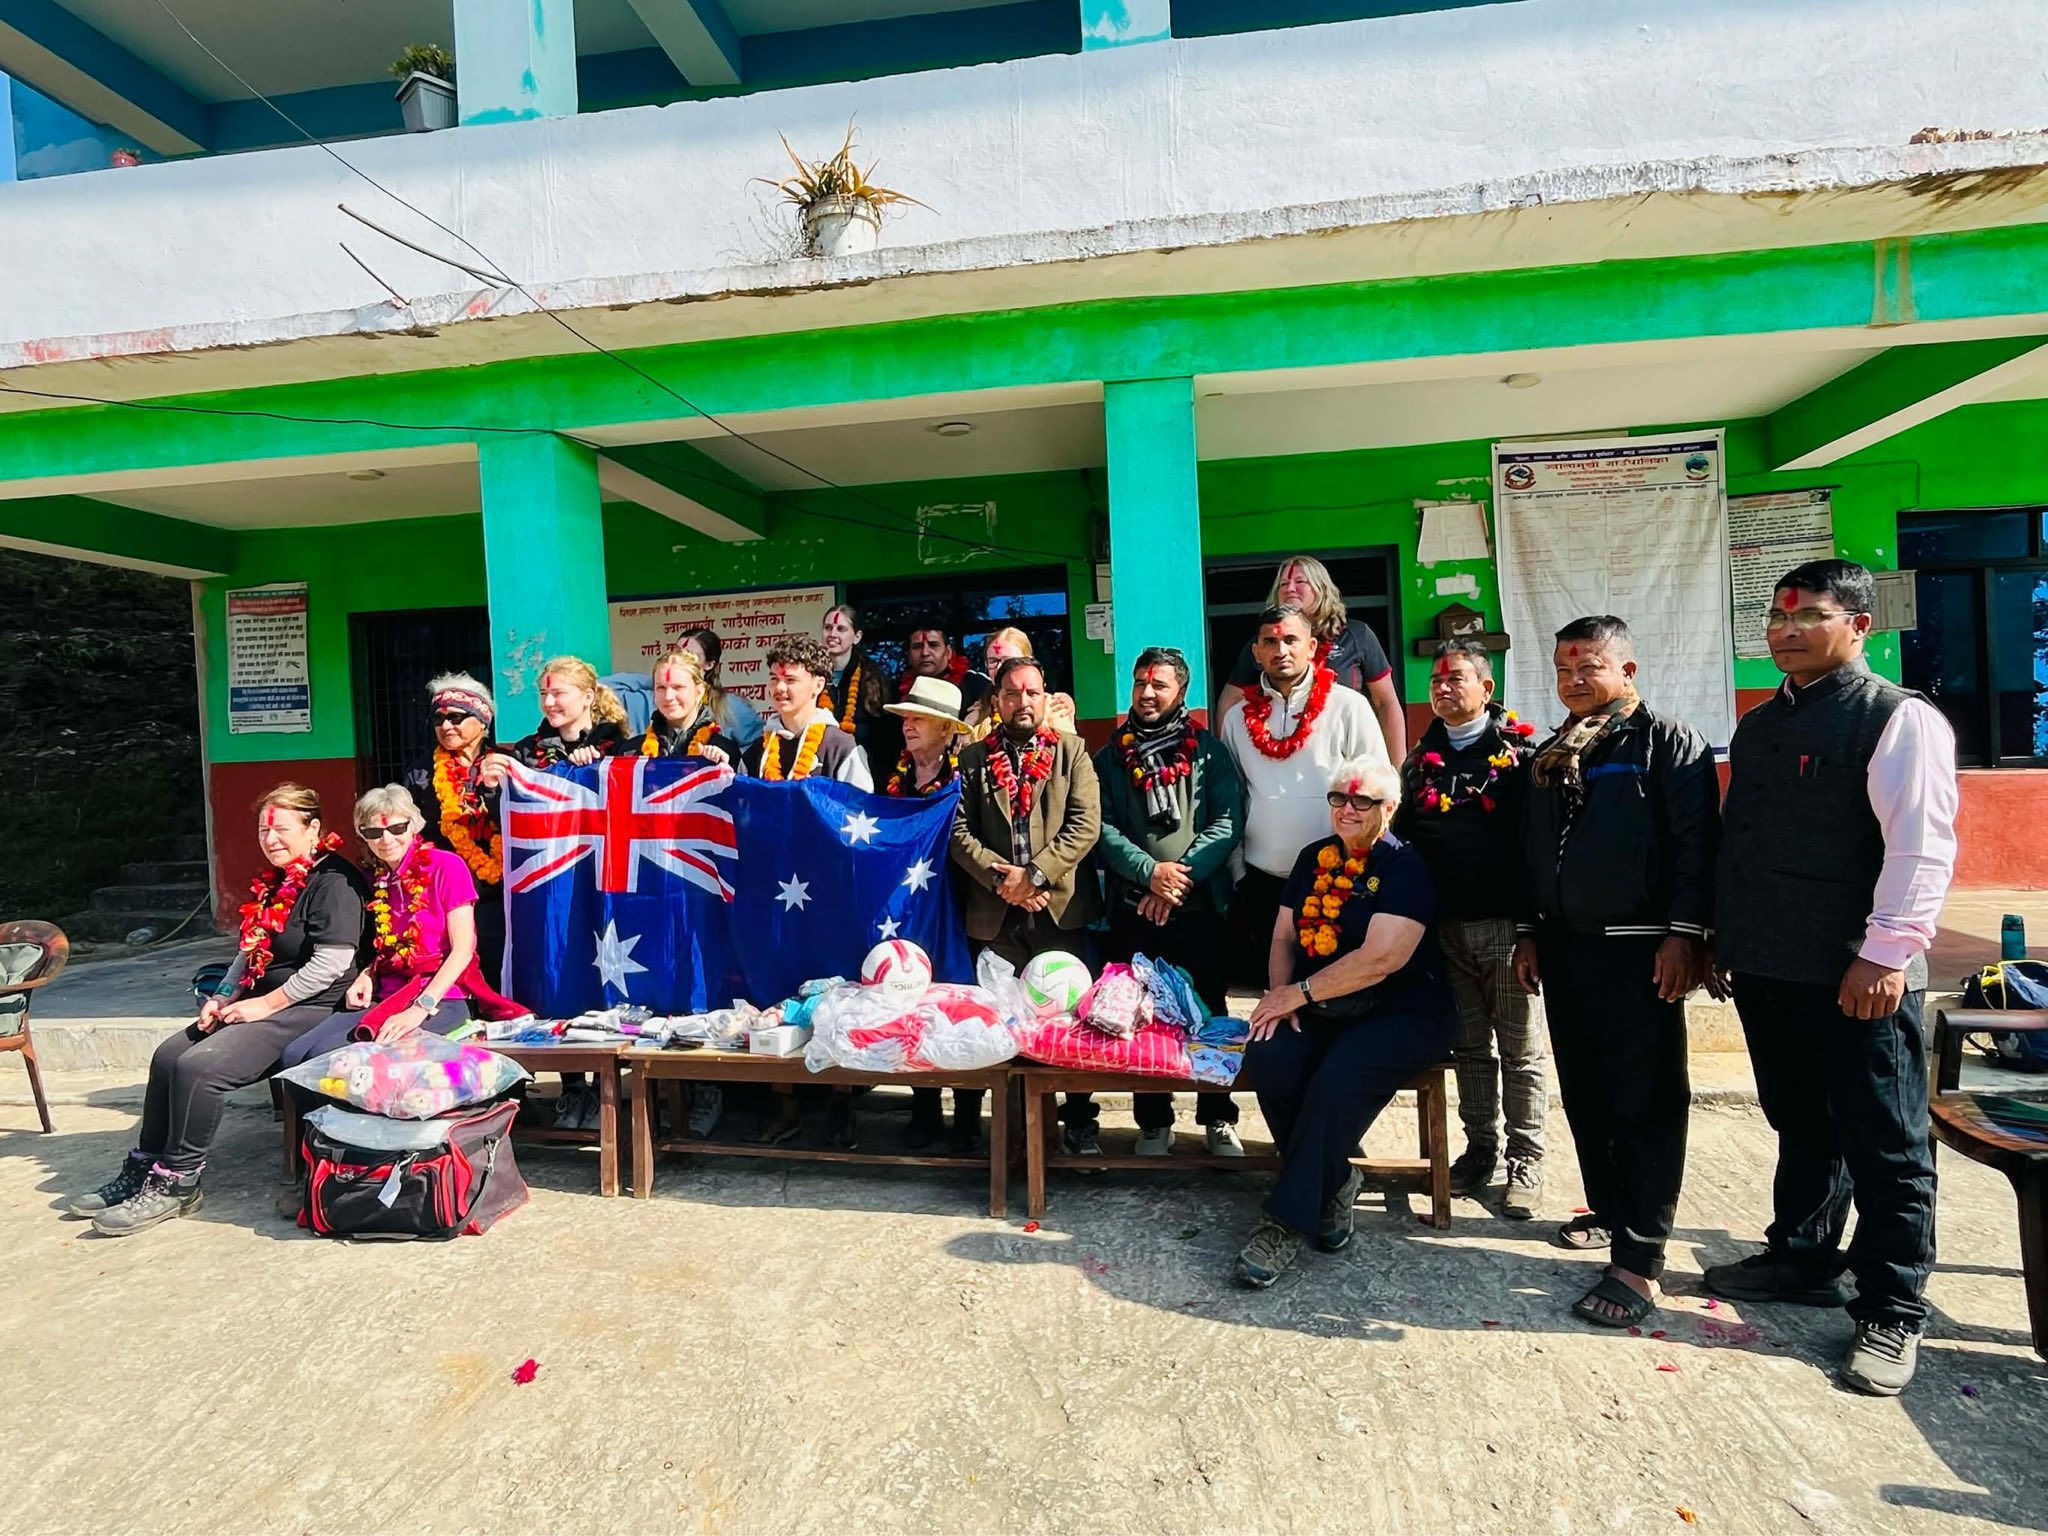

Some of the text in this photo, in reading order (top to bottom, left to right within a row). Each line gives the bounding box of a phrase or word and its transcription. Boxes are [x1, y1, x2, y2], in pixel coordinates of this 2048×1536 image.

[662, 610, 786, 634] ज्वालामखी गाउँपालिका
[728, 660, 762, 676] शाखा
